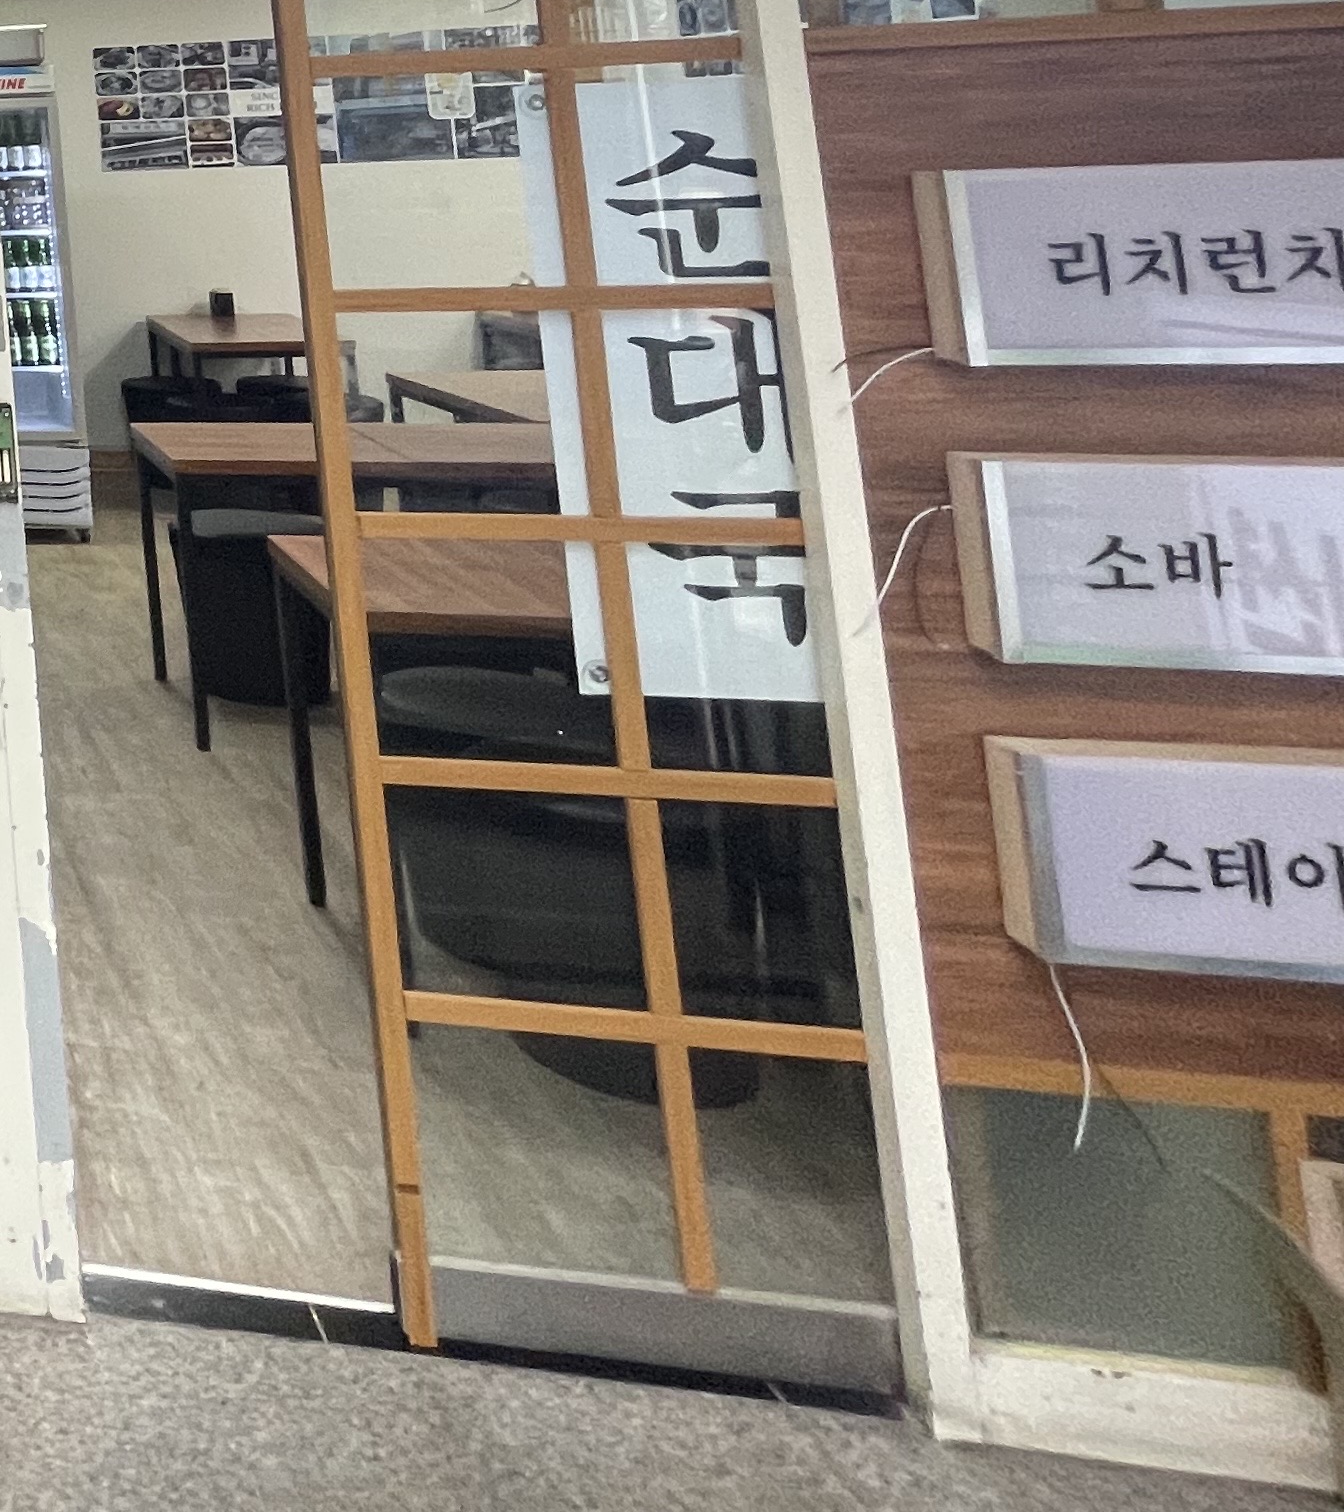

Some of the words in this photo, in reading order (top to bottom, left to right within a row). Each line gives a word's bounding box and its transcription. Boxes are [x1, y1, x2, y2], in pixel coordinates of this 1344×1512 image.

[1047, 228, 1344, 296] 리치런치
[1083, 531, 1233, 600] 소바
[1129, 839, 1344, 909] 스테이
